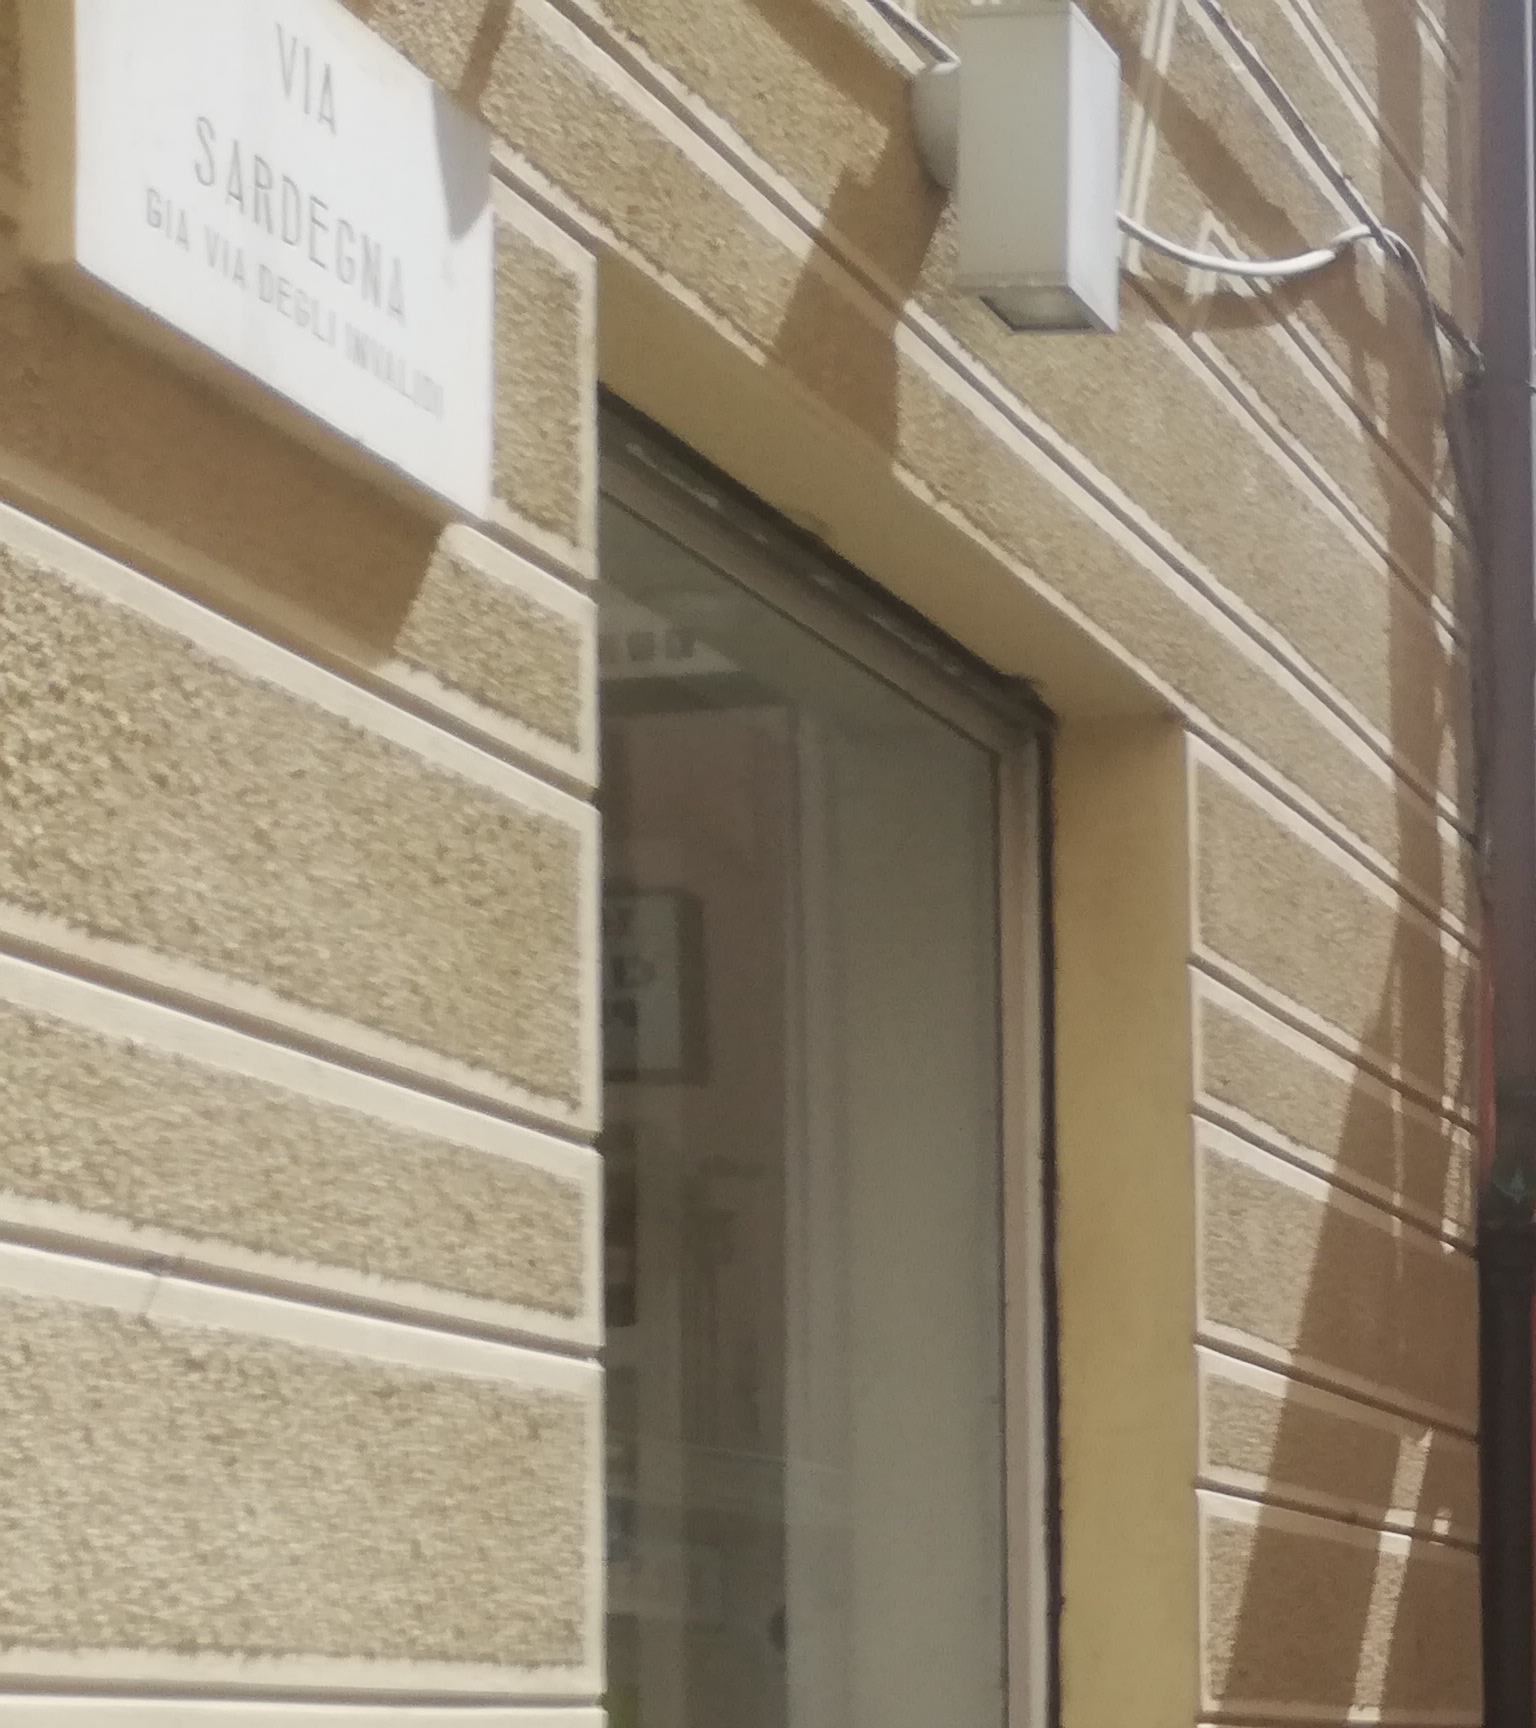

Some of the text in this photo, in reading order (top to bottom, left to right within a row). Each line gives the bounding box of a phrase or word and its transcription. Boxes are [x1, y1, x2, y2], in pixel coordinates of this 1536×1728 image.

[275, 22, 338, 135] VIA
[194, 116, 406, 327] SARDEGNA
[204, 225, 246, 289] VIA
[258, 263, 336, 348] DEGLI
